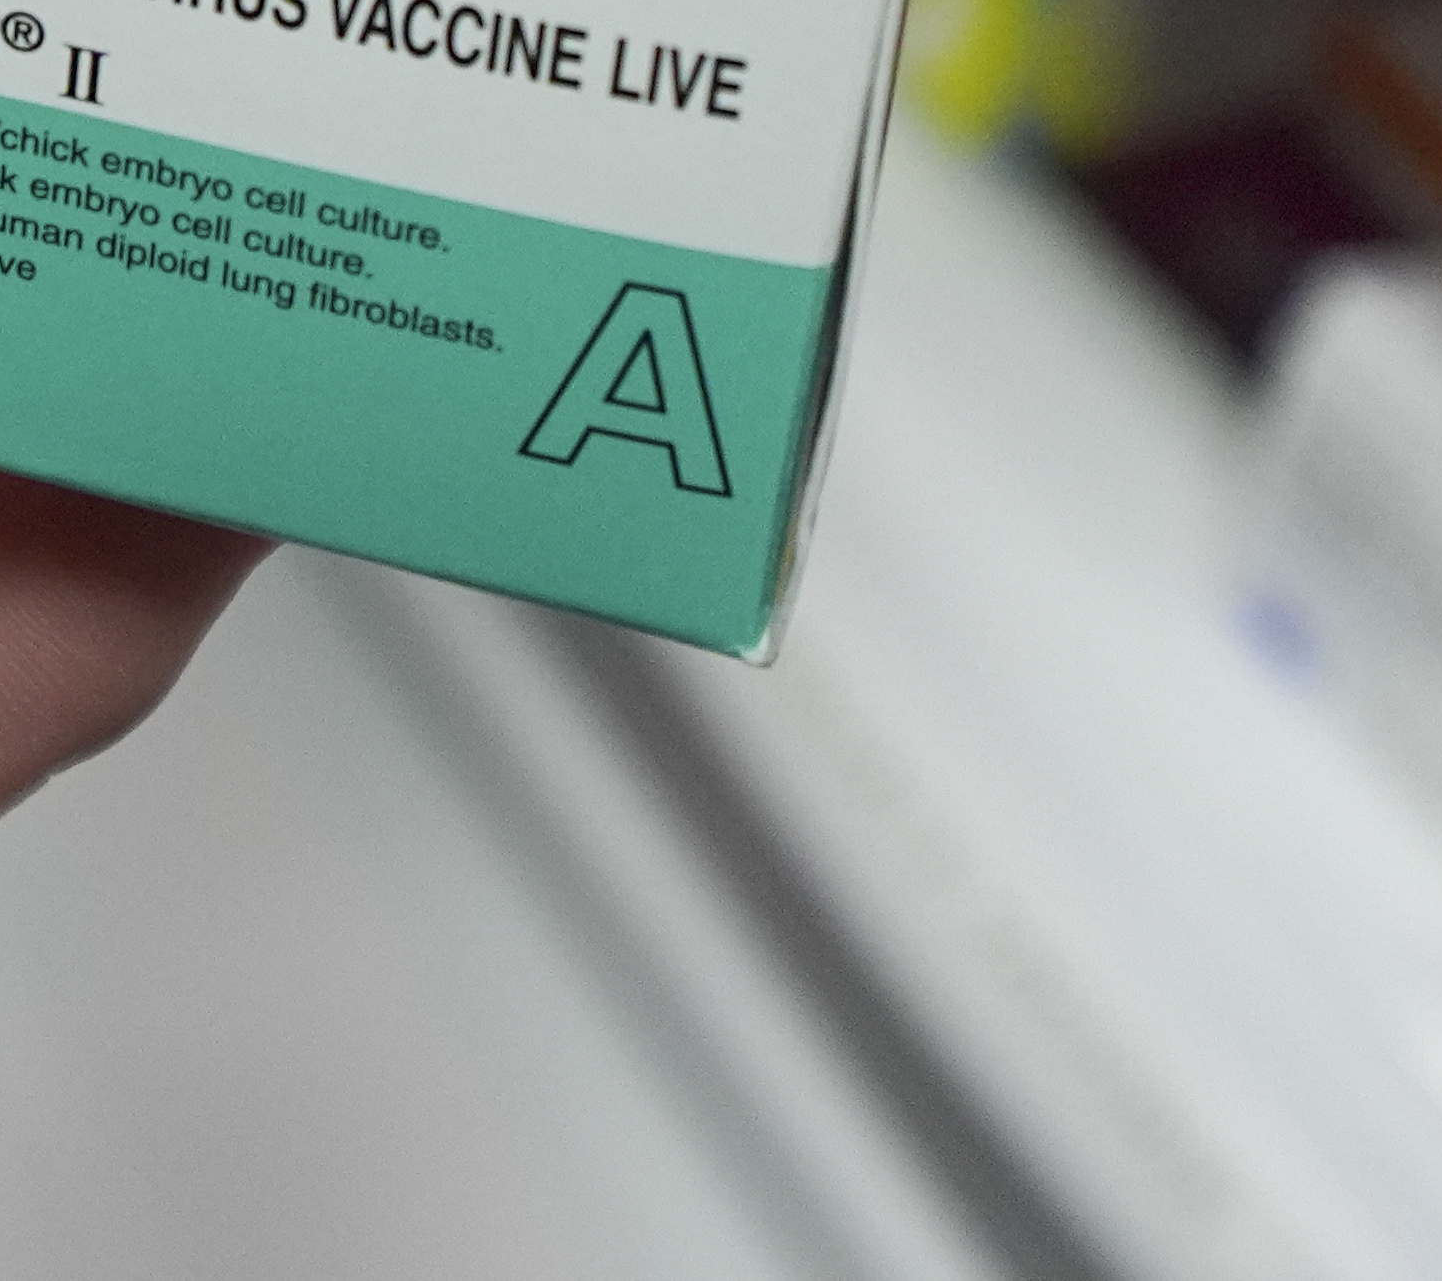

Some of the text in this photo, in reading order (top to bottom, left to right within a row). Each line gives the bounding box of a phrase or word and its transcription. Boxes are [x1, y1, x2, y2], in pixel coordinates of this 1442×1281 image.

[58, 42, 110, 107] II
[609, 37, 749, 122] LIVE
[30, 175, 161, 227] embryo
[171, 211, 233, 245] cell
[243, 227, 375, 280] culture.
[100, 150, 234, 203] embryo
[244, 185, 307, 219] cell
[317, 200, 452, 254] culture.
[95, 232, 211, 283] diploid
[221, 261, 297, 311] lung
[308, 280, 504, 354] fibroblasts.
[519, 279, 734, 501] A
